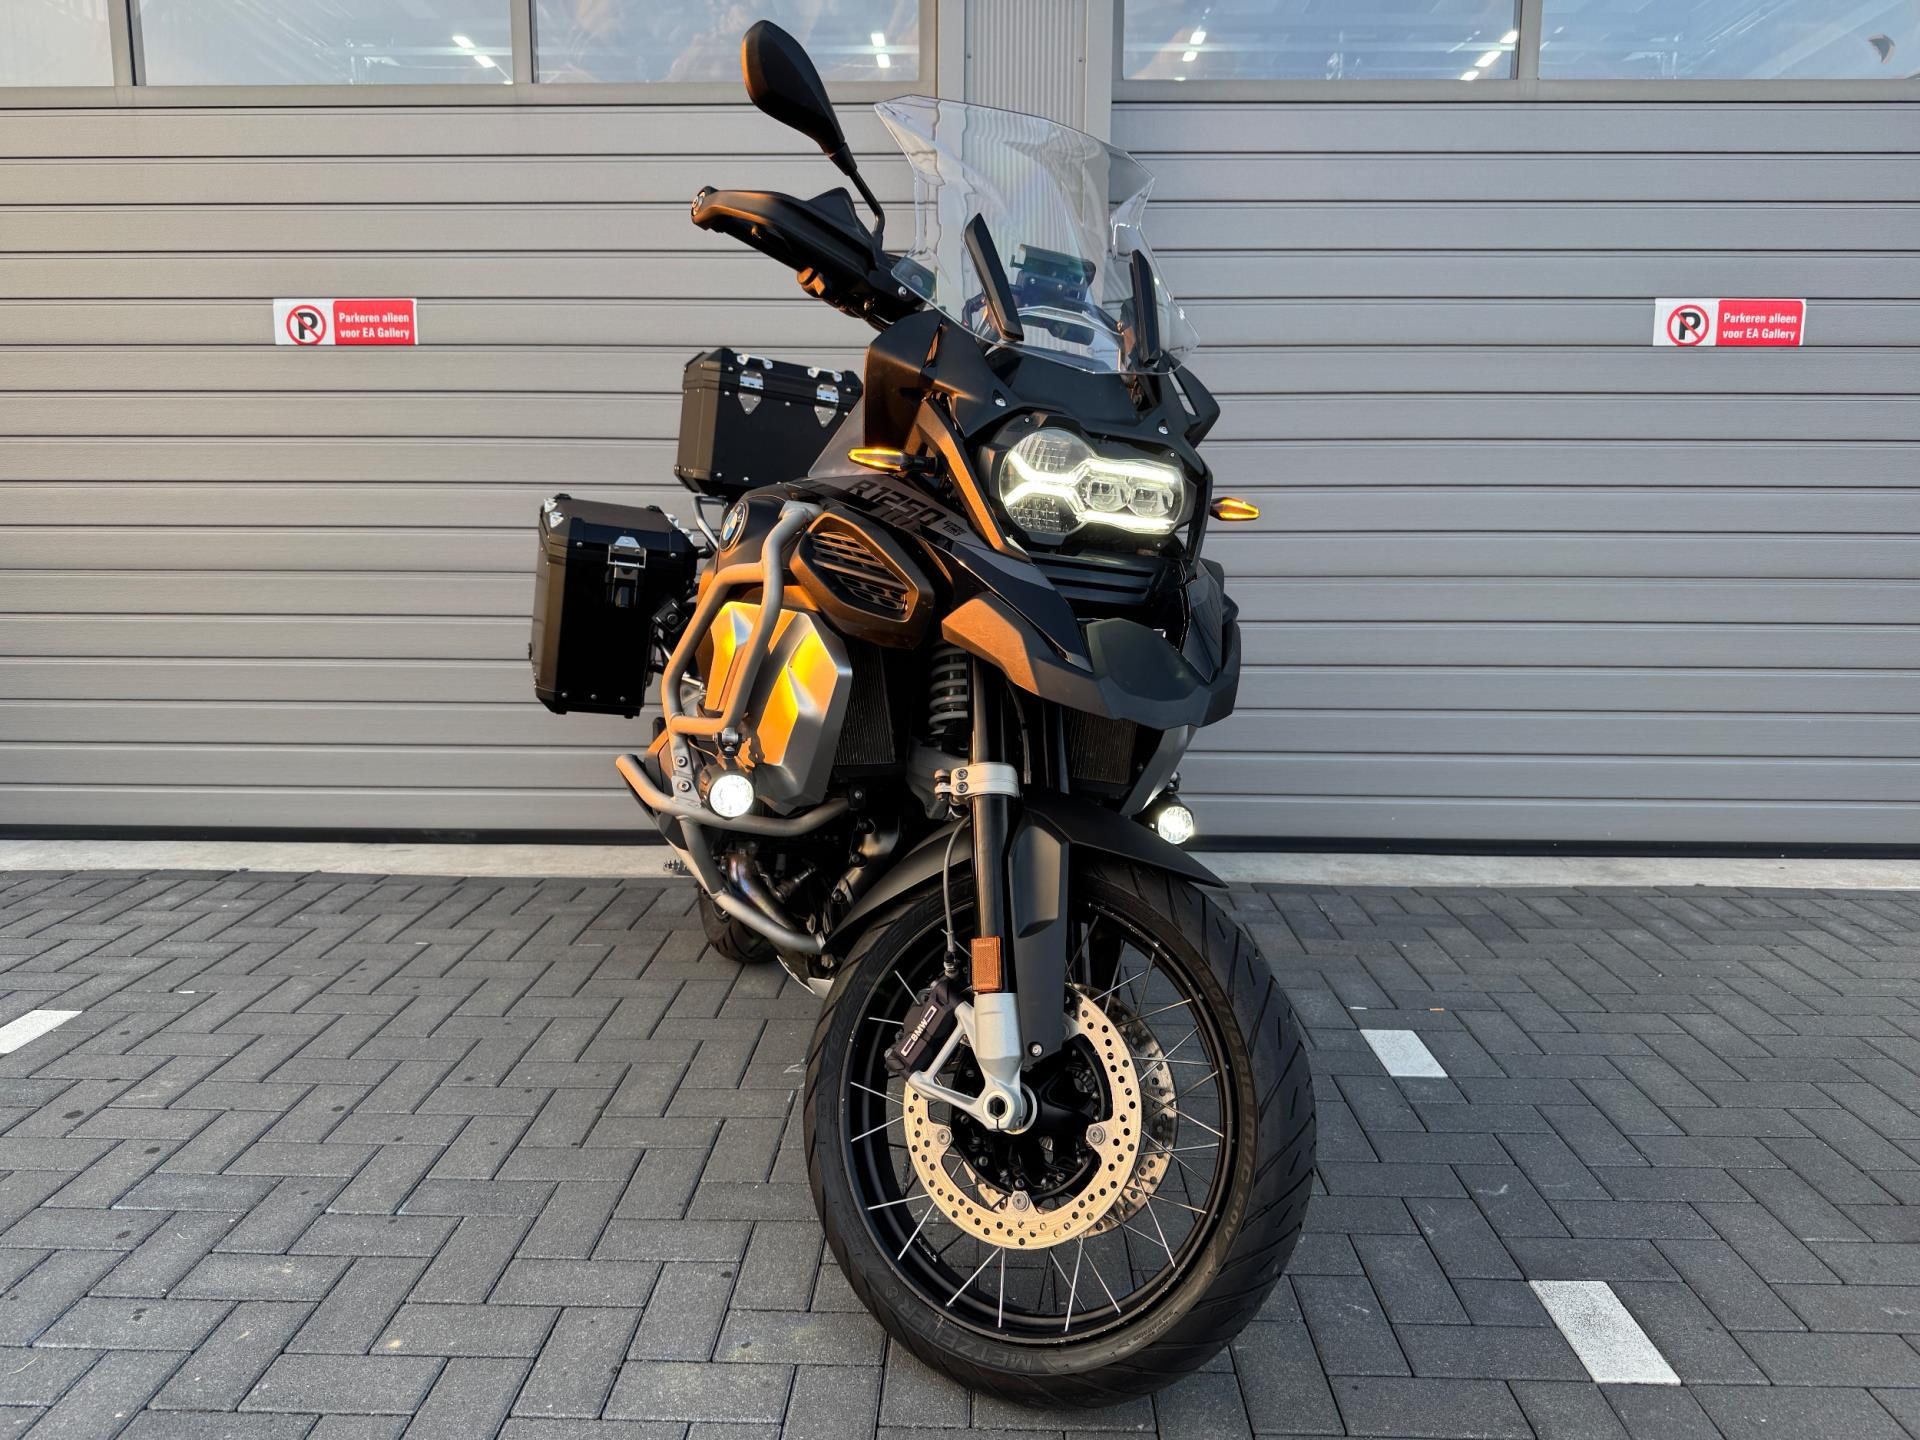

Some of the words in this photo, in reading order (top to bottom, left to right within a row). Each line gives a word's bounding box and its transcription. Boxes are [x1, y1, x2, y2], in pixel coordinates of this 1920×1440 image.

[339, 312, 379, 323] Parkeren
[382, 312, 409, 323] alleen
[1723, 312, 1766, 323] Parkeren
[1768, 313, 1797, 323] alleen
[340, 329, 360, 338] voor
[362, 328, 375, 338] EA
[377, 328, 410, 340] Gallery
[1722, 330, 1743, 339] voor
[1746, 329, 1759, 338] EA
[1761, 328, 1796, 341] Gallery
[910, 1018, 929, 1042] BMW
